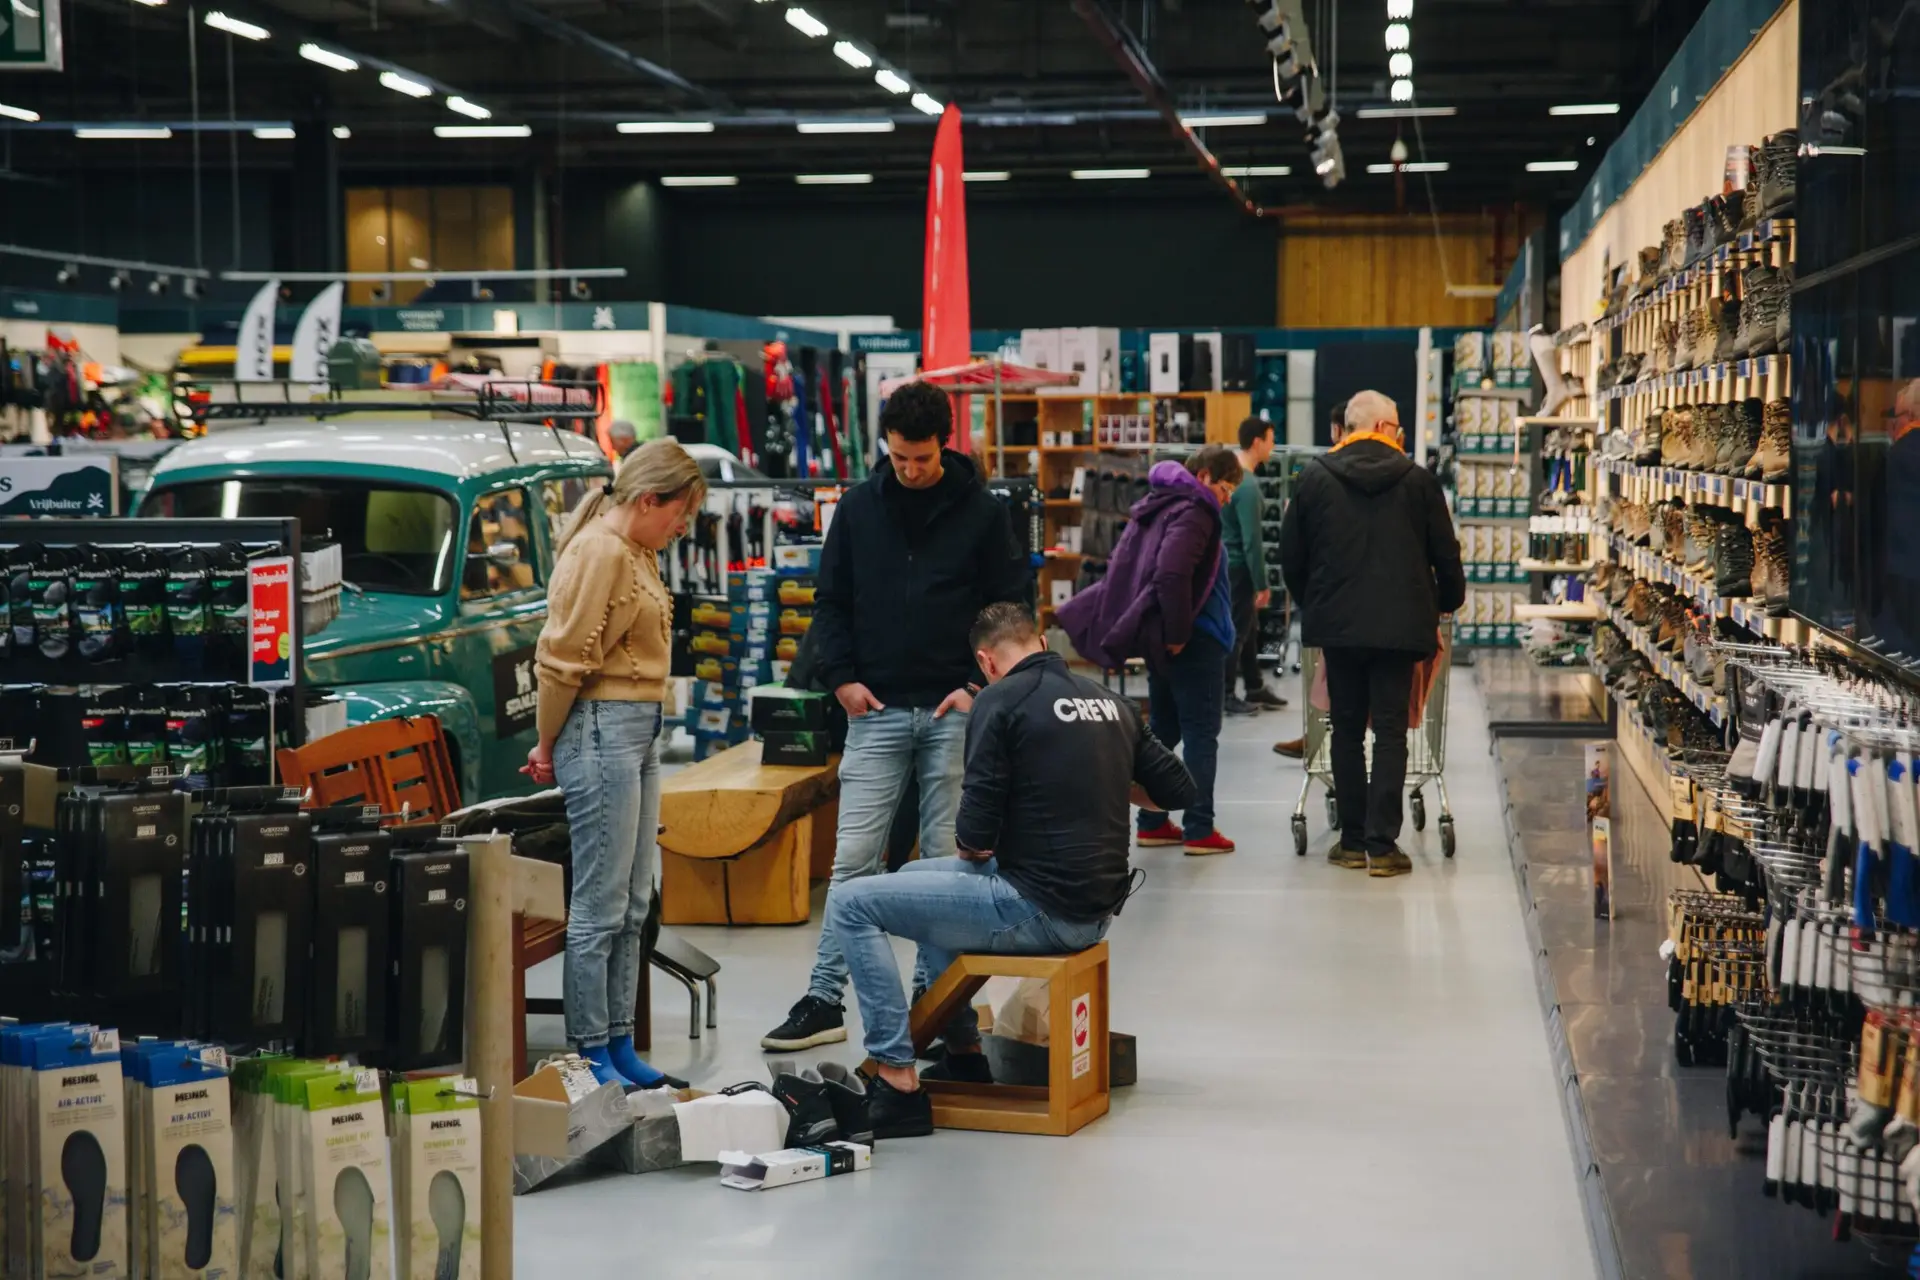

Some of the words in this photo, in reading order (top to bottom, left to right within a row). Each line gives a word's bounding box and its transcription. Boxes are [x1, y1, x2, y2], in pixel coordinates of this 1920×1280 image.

[30, 498, 82, 510] Vrijbuiter
[1053, 698, 1120, 722] CREW
[62, 1073, 100, 1087] MEINDL
[175, 1088, 209, 1102] MEINDL
[331, 1112, 364, 1126] MEINDL
[430, 1119, 462, 1130] MEINDL
